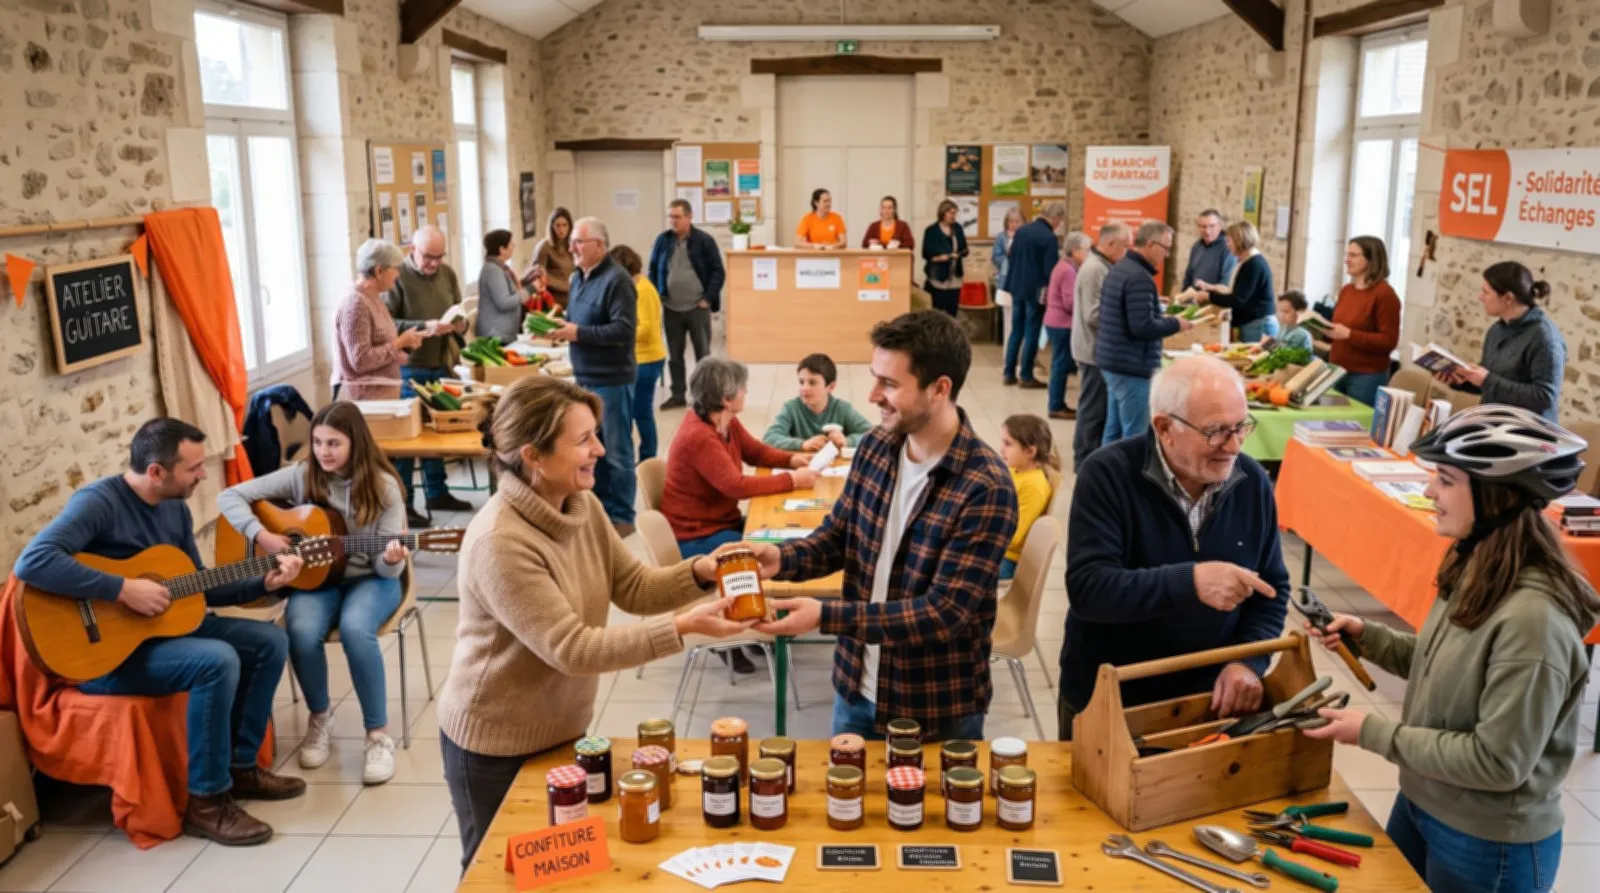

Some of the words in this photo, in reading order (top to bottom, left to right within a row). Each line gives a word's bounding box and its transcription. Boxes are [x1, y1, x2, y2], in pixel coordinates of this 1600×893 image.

[1093, 170, 1108, 180] DU
[1111, 169, 1160, 181] PARTAGE
[1096, 157, 1109, 168] LE
[1112, 155, 1157, 168] MARCHÉ
[1450, 172, 1498, 215] SEL
[1519, 195, 1595, 231] Échanges
[515, 825, 597, 859] CONFITURE
[533, 849, 591, 877] MAISON
